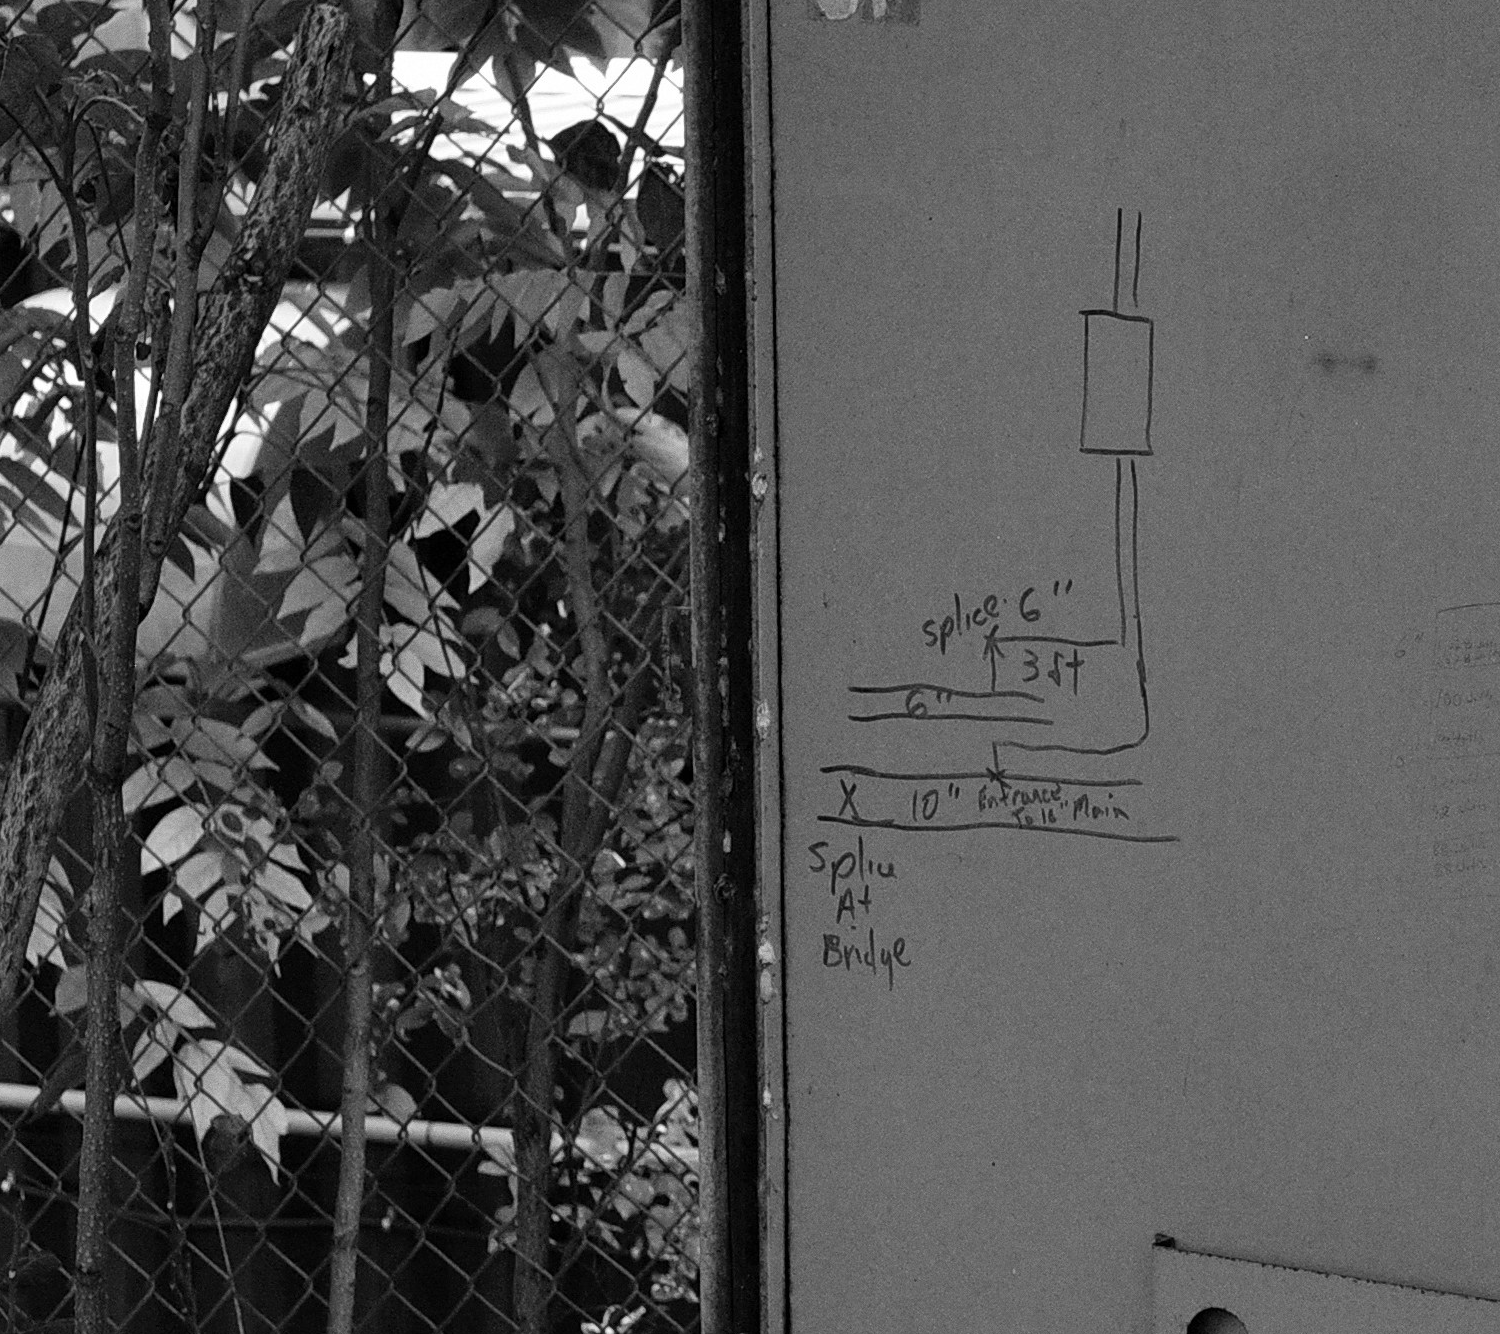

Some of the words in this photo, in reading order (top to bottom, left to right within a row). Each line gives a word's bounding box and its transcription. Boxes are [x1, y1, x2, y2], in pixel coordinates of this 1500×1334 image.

[912, 783, 960, 822] 10"
[1073, 793, 1129, 821] Main
[836, 884, 872, 924] At
